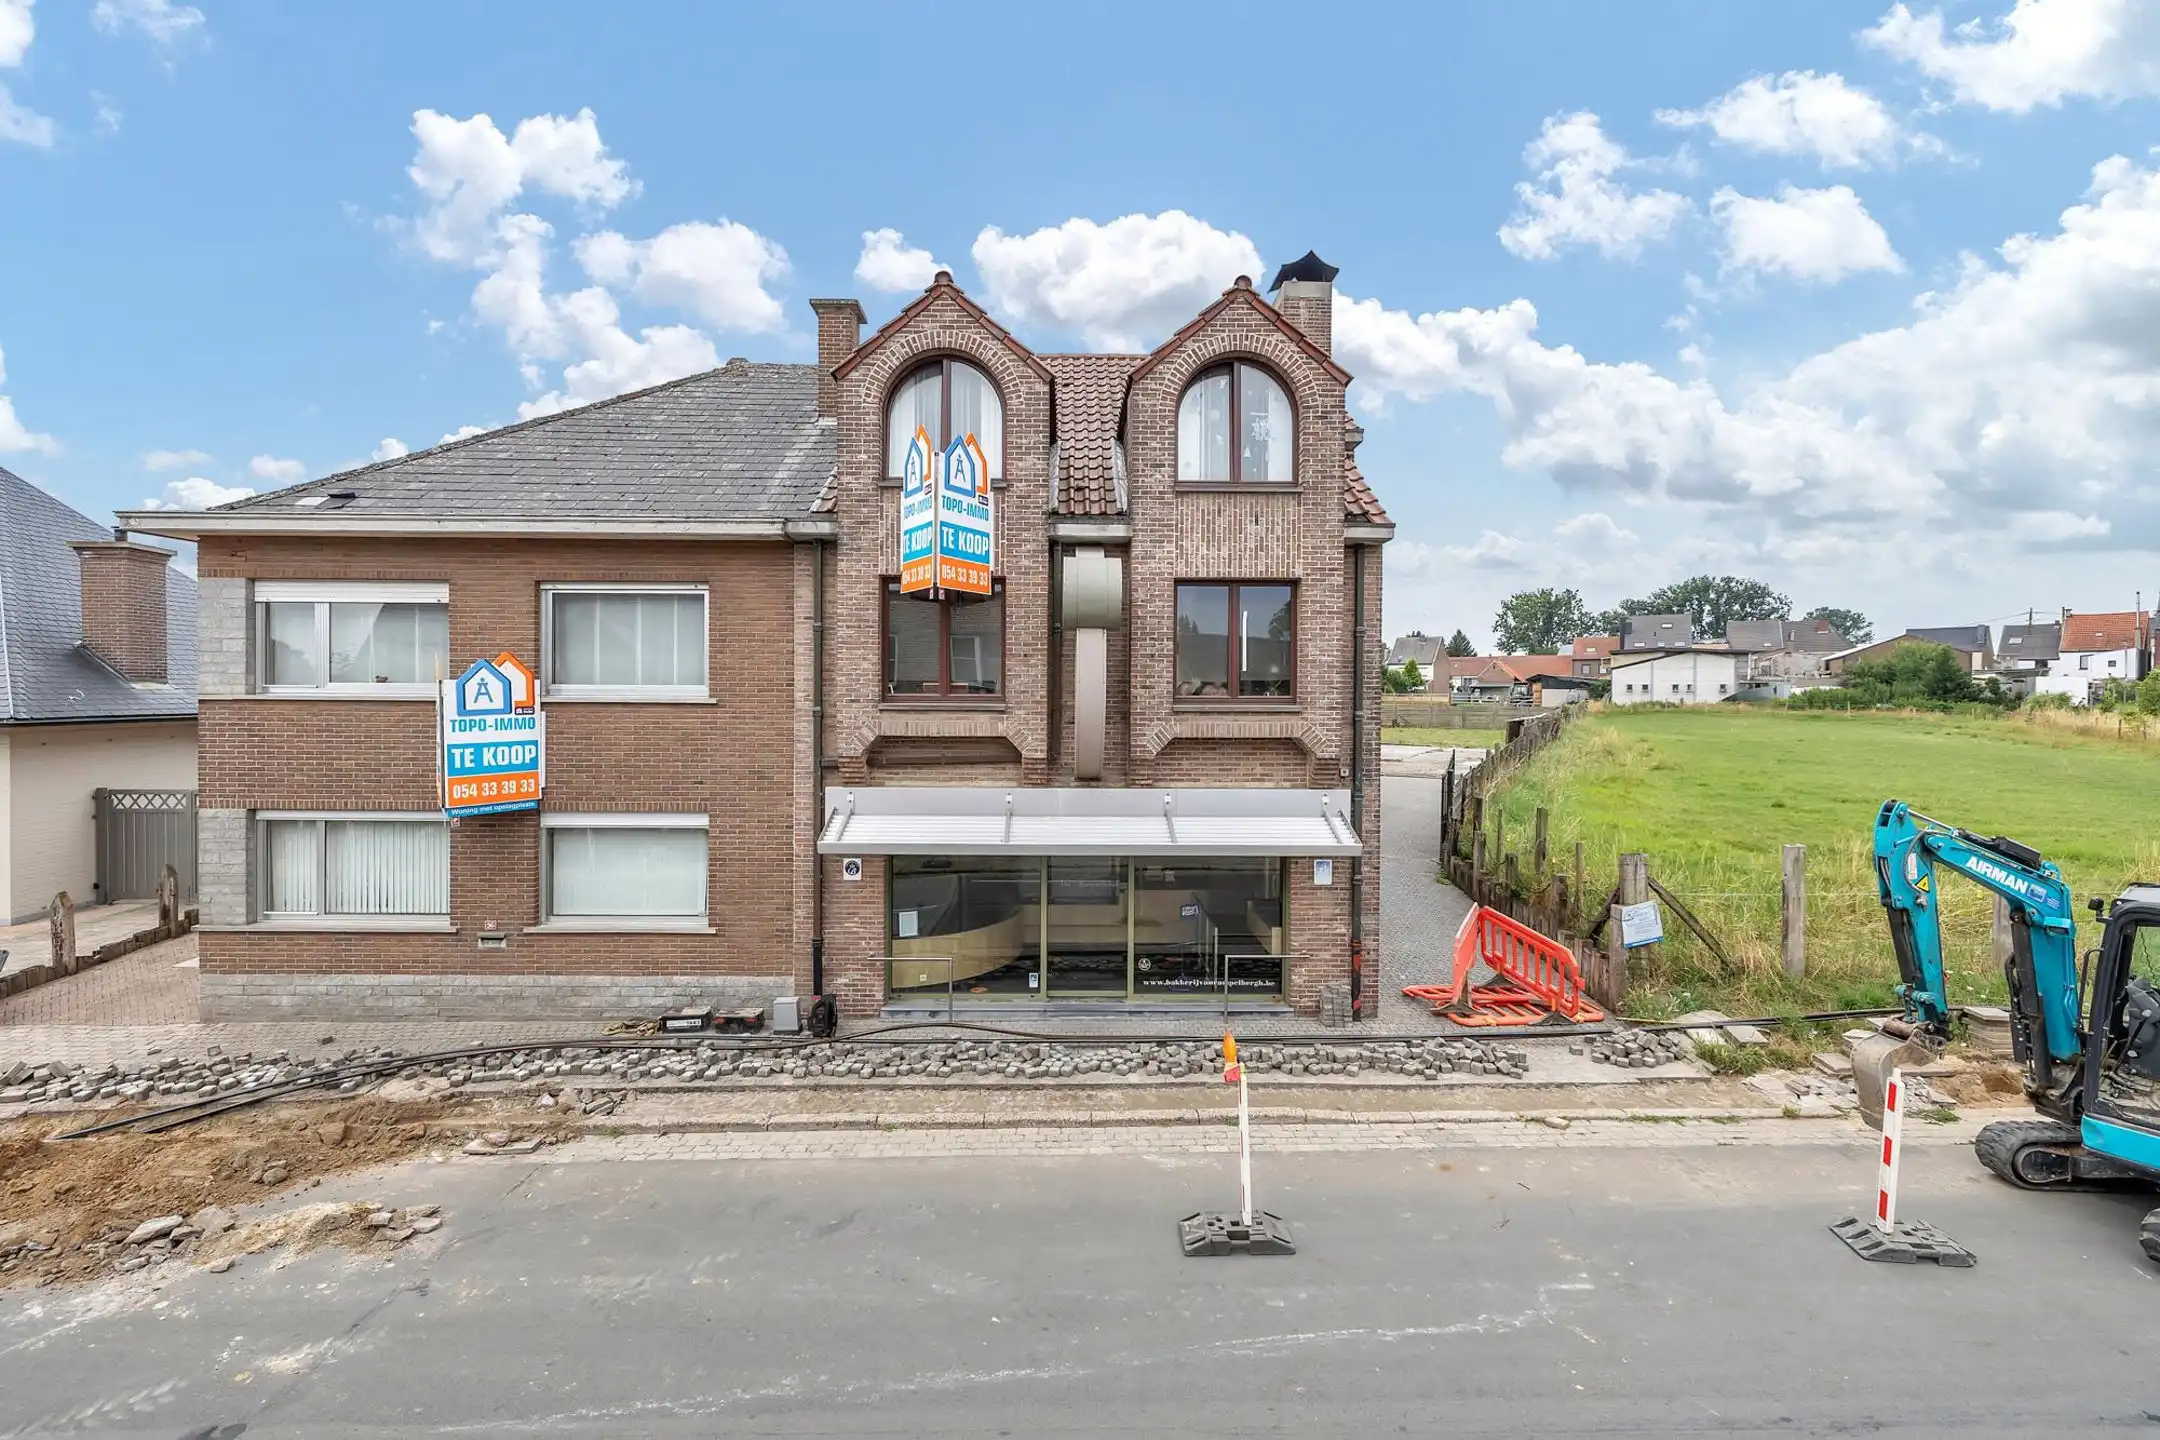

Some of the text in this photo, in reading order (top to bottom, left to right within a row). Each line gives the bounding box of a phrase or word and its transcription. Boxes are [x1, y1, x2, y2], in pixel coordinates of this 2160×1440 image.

[942, 495, 989, 521] TOPO-IMMO
[911, 526, 932, 552] KOOP
[942, 526, 988, 556] TE KOOP
[942, 564, 988, 587] 054 33 39 33
[450, 717, 536, 733] TOPO-IMMO
[451, 744, 536, 769] TE KOOP
[452, 778, 536, 799] 054 33 39 33
[451, 808, 478, 816] Woning
[1965, 856, 2029, 894] AIRMAN
